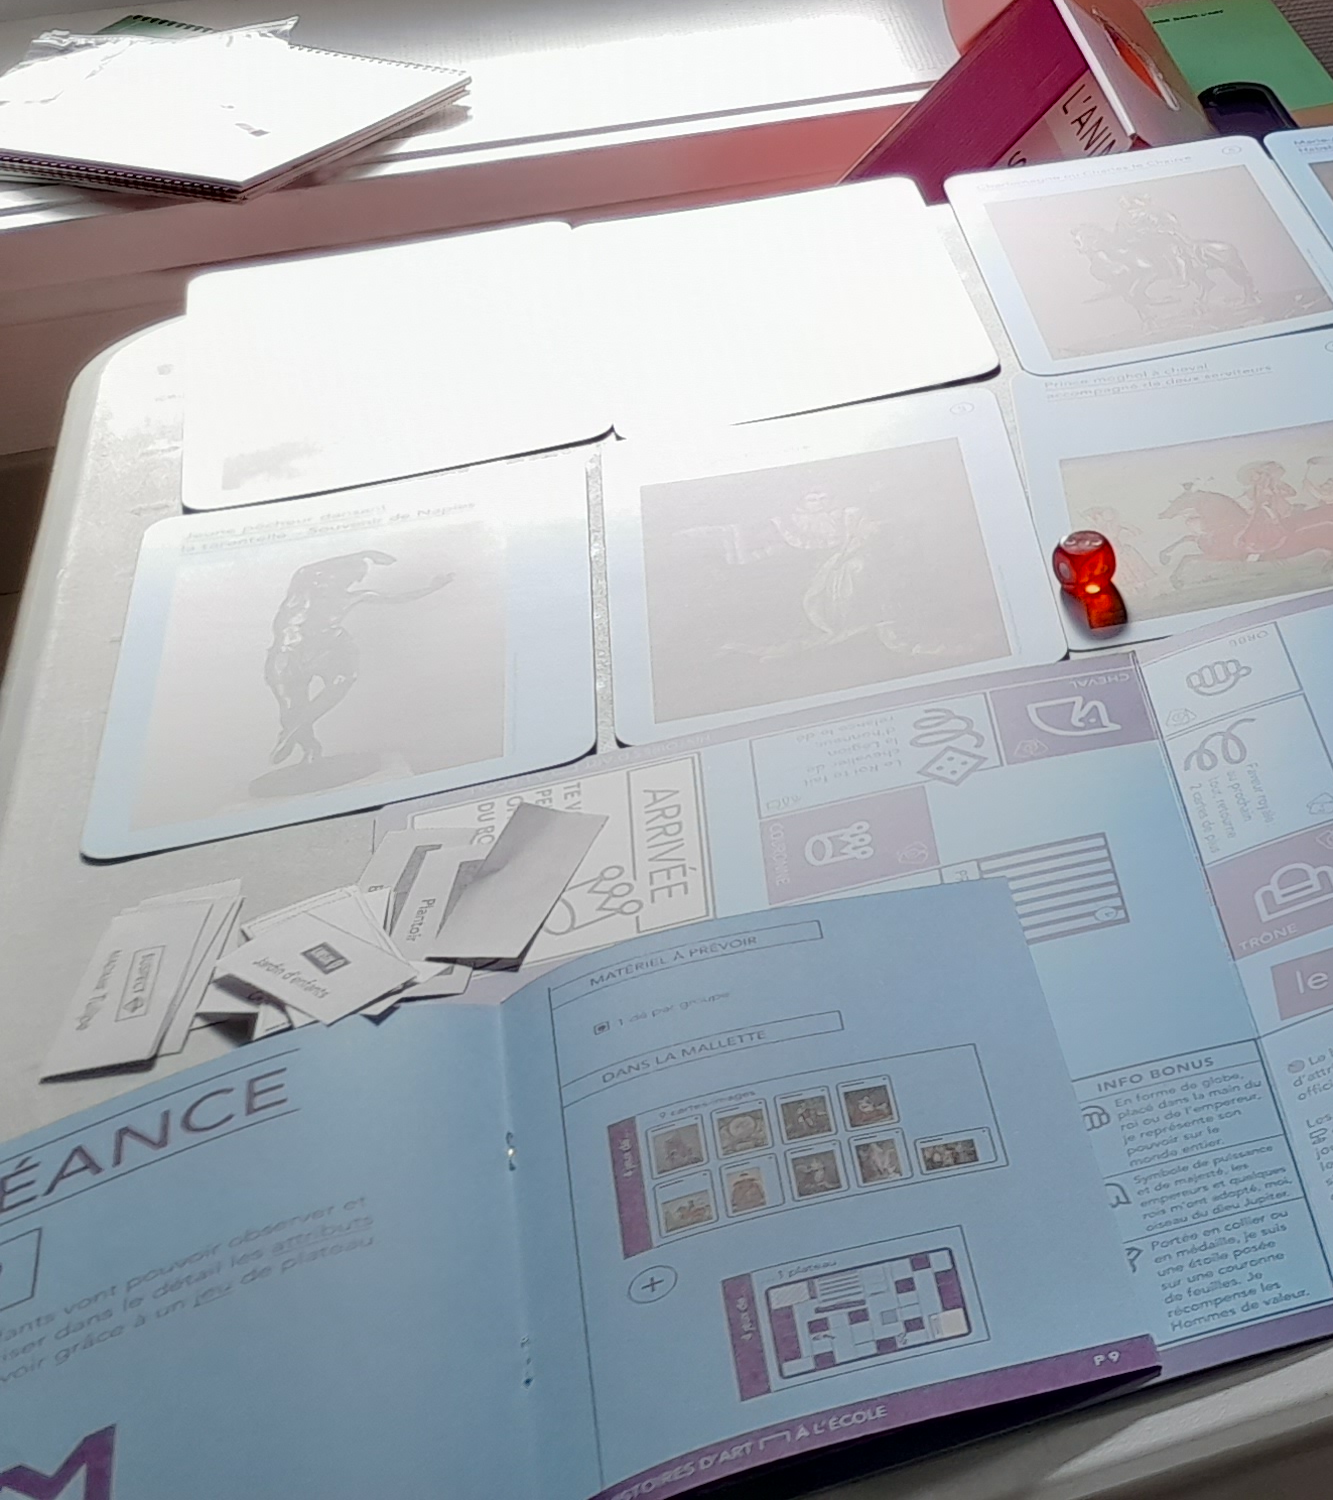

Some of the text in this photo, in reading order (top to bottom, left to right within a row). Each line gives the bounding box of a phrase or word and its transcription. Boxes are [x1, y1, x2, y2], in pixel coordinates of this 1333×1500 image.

[1062, 84, 1116, 157] L'ANI
[1066, 672, 1131, 691] CHEVAL
[643, 788, 697, 904] ARRIVÉE
[767, 821, 792, 886] COURONNE
[405, 898, 436, 942] Plantoir
[1238, 922, 1298, 952] TRÔNE
[252, 956, 285, 974] Jardin
[589, 936, 758, 987] MATÉRIEL À PRÉVOIR
[1293, 969, 1329, 994] le
[601, 1030, 767, 1083] DANS LA MALLETTE
[1096, 1057, 1215, 1093] INFO BONUS
[1308, 1054, 1325, 1066] Le
[1092, 1350, 1121, 1368] P 9
[698, 1404, 888, 1471] D'ART À L'ÉCOLE
